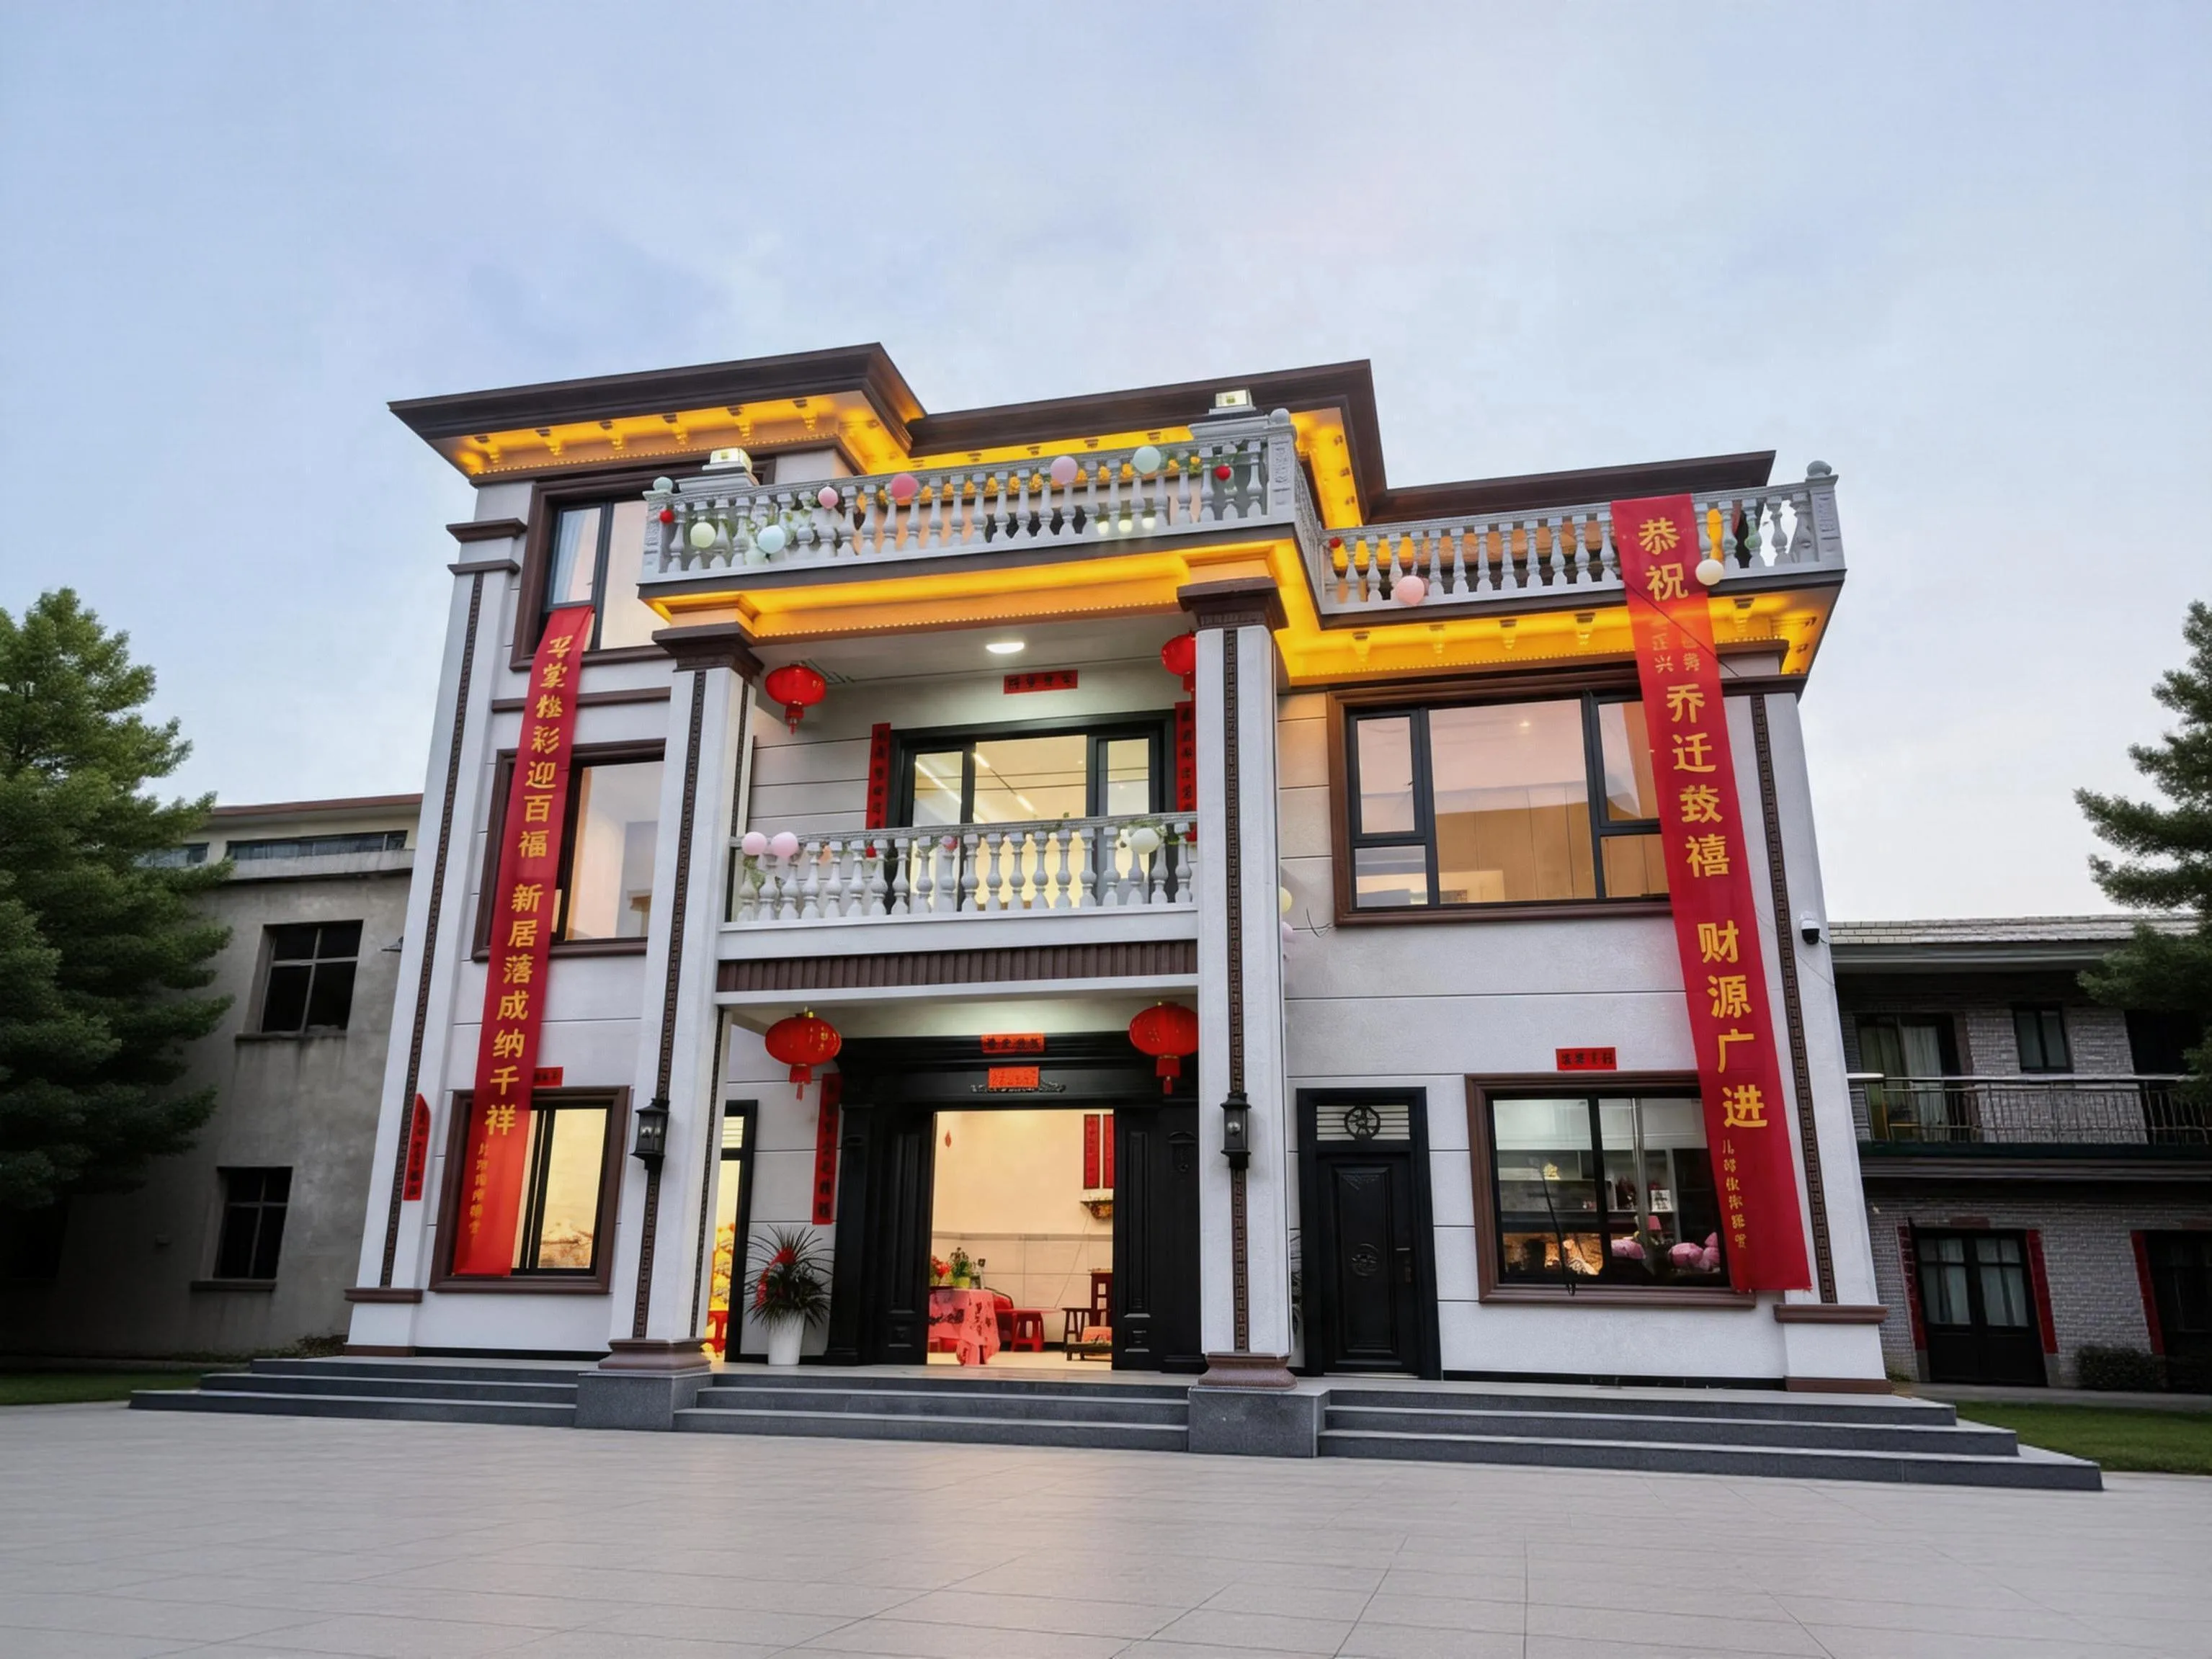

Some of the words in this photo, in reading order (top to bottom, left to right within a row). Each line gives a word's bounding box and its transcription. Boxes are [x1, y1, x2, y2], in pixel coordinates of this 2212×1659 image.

[1638, 517, 1689, 602] 恭祝
[483, 883, 544, 1137] 新居落成纳千祥
[1697, 919, 1768, 1128] 财源广进
